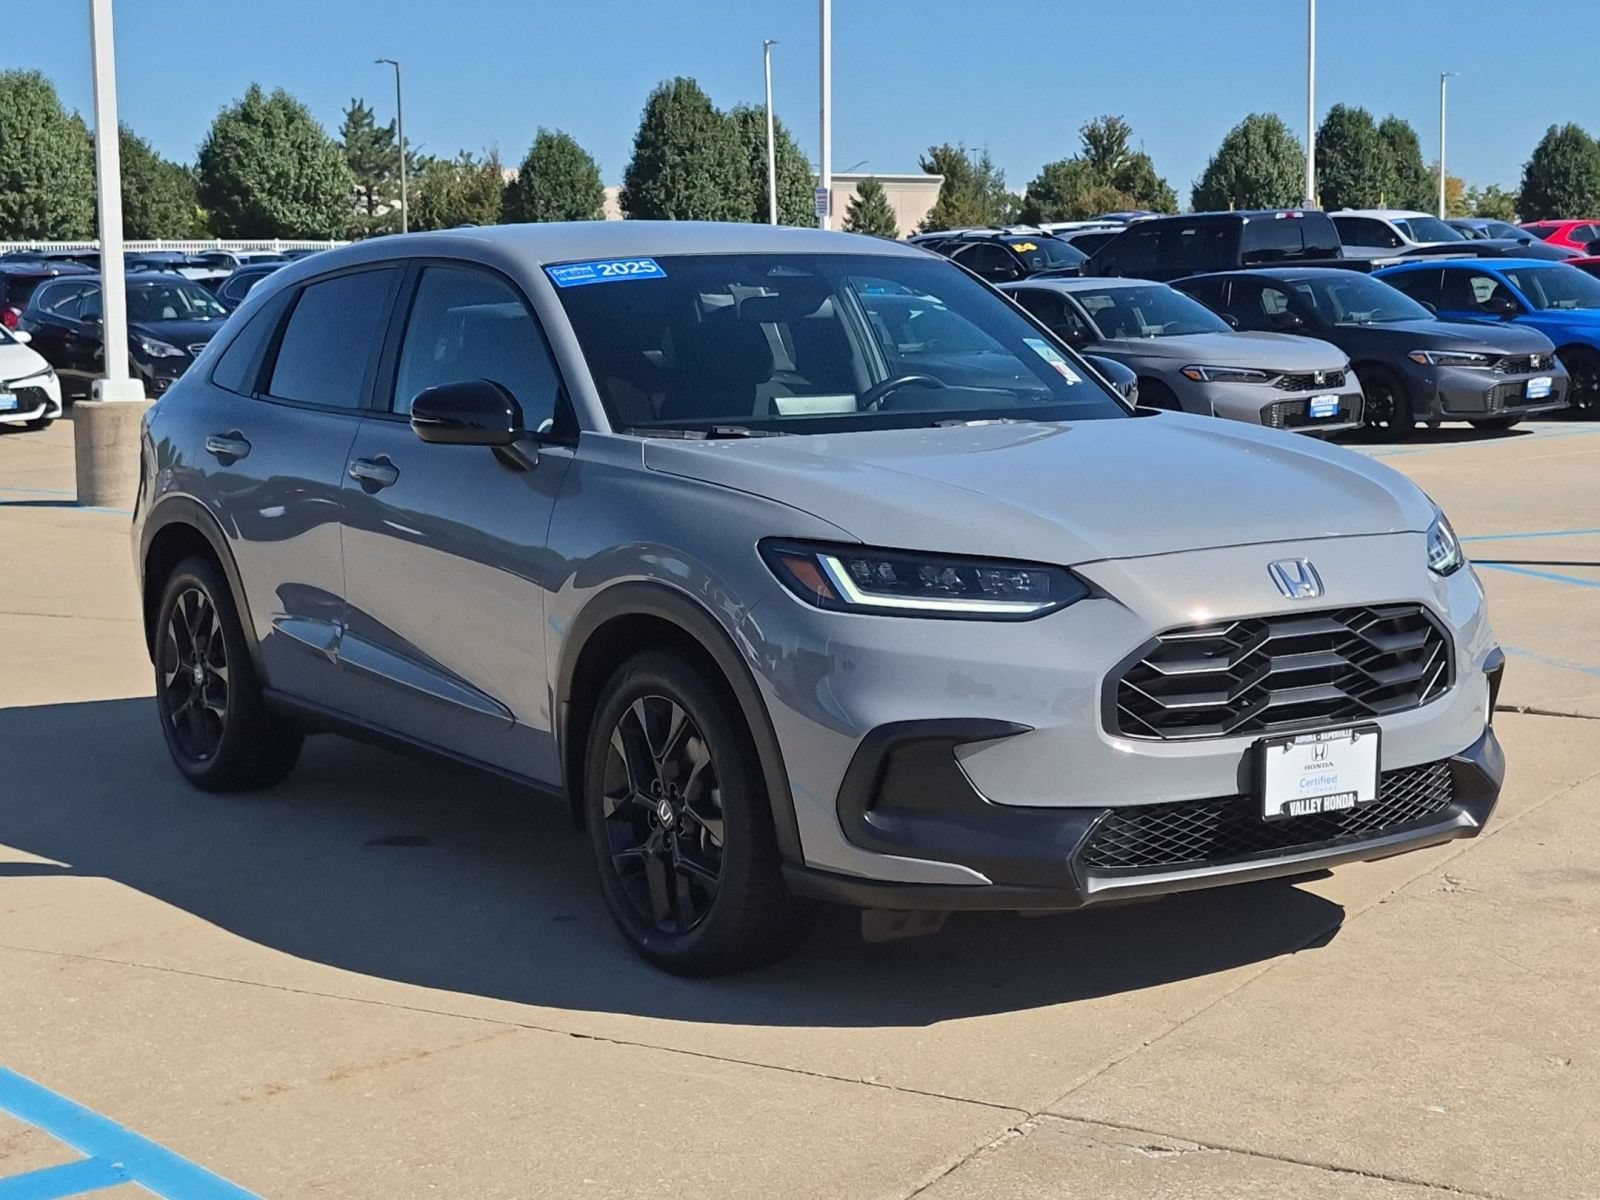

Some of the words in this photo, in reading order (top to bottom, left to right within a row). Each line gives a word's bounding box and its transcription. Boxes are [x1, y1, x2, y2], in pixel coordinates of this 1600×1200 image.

[597, 261, 657, 276] 2025
[1304, 761, 1334, 771] HONDA
[1300, 774, 1338, 788] Certified
[1289, 798, 1322, 816] VALLEY
[1323, 793, 1355, 811] HONDA
